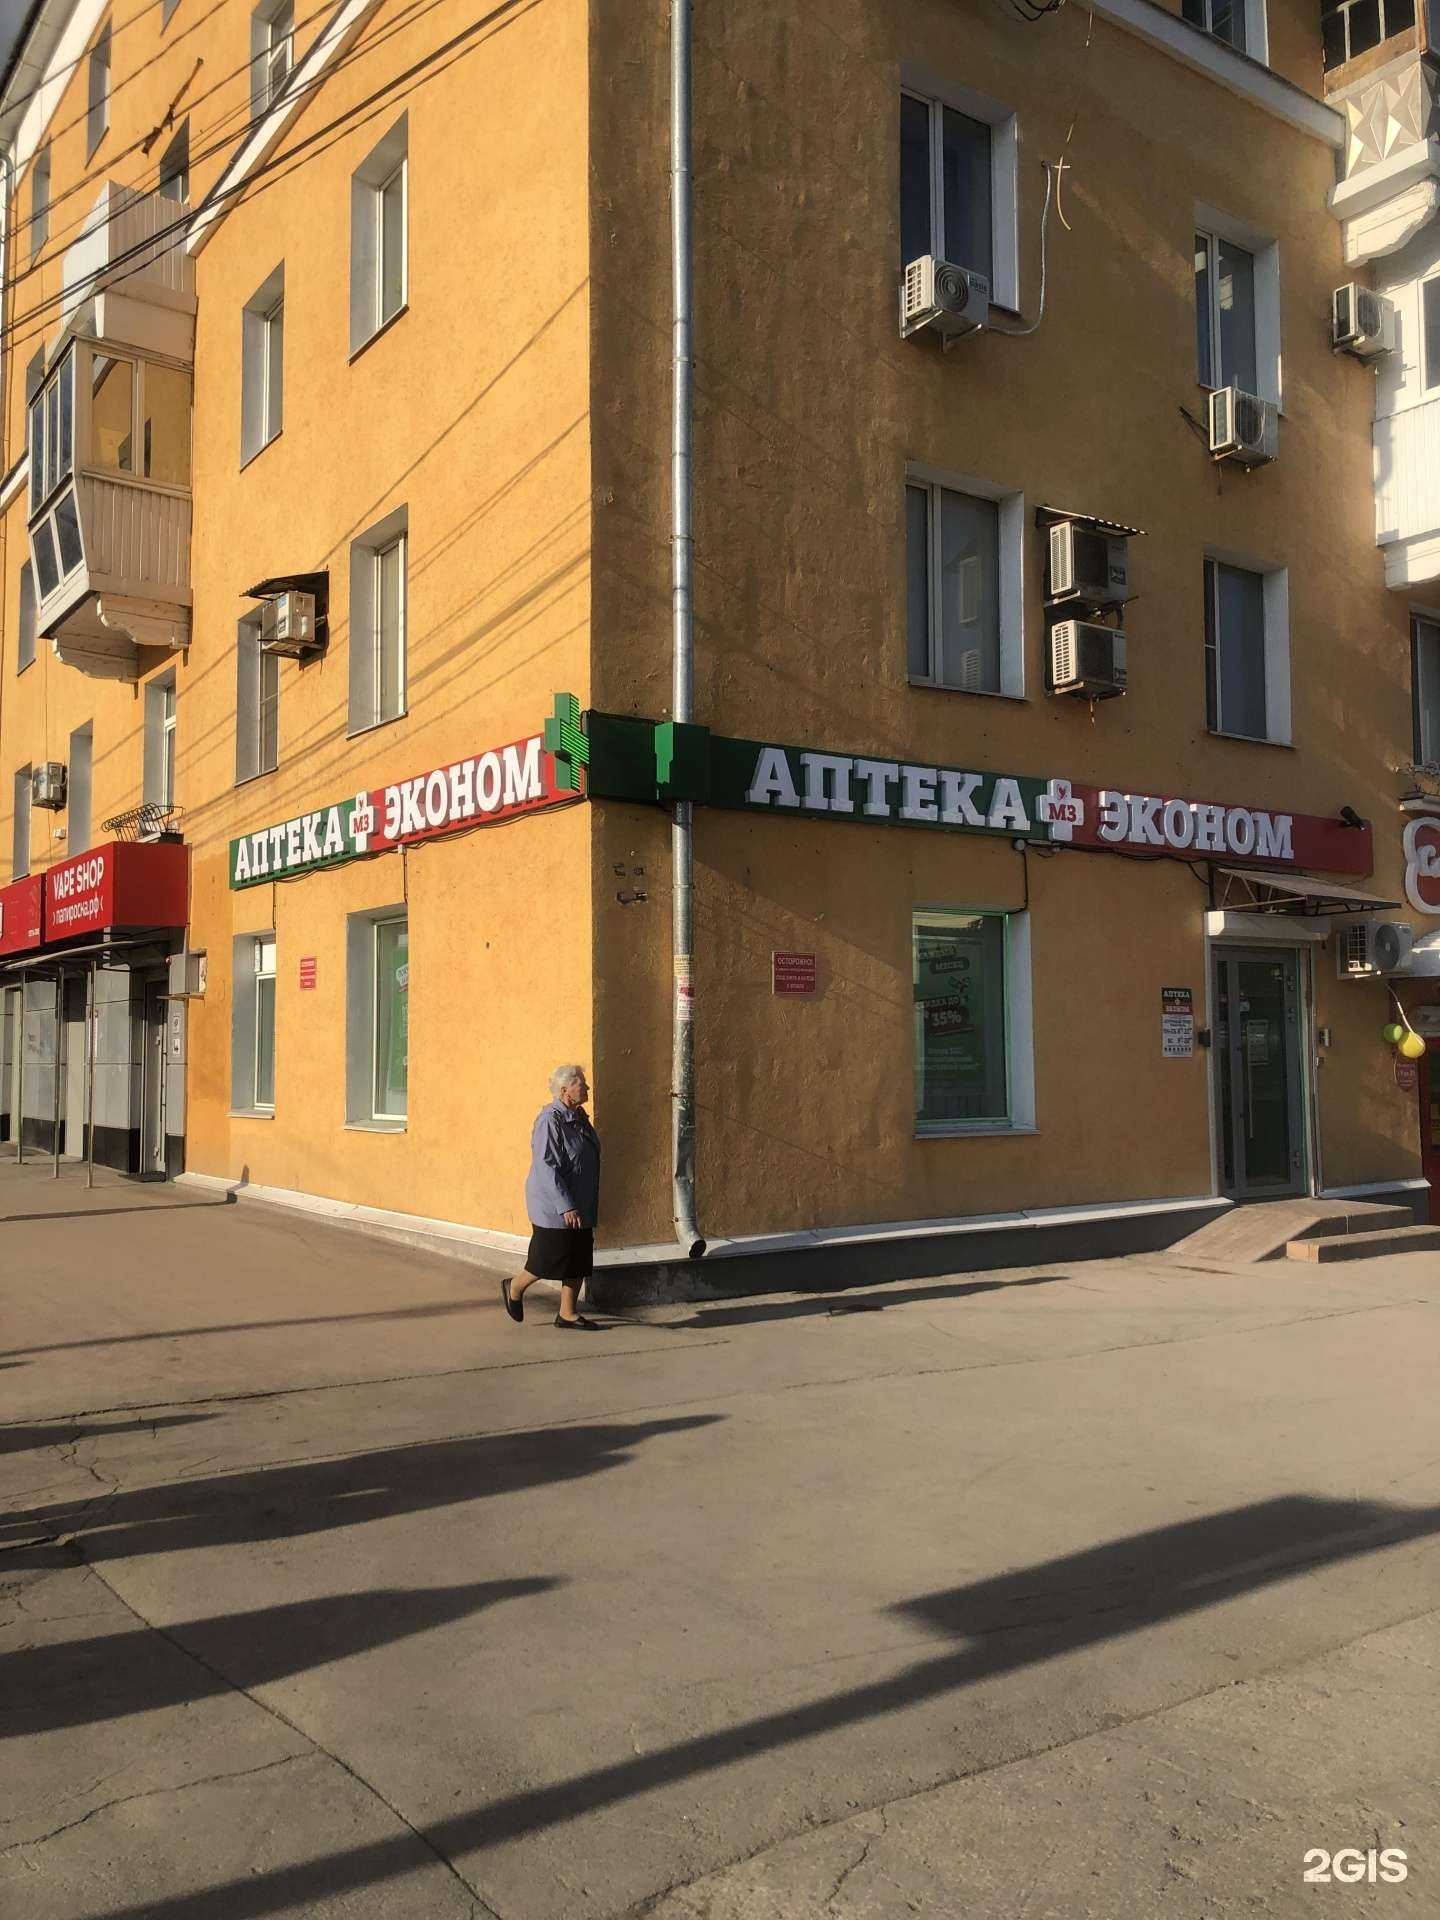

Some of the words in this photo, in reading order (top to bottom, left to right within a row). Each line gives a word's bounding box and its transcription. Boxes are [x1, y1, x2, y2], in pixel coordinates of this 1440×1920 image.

[234, 806, 344, 882] АПТЕКА
[383, 737, 543, 839] ЭКОНОМ
[744, 747, 1031, 831] АПТЕКА
[1098, 791, 1294, 859] ЭКОНОМ
[53, 867, 76, 900] VAPE
[77, 856, 105, 894] SHOP
[931, 1010, 962, 1026] 35%
